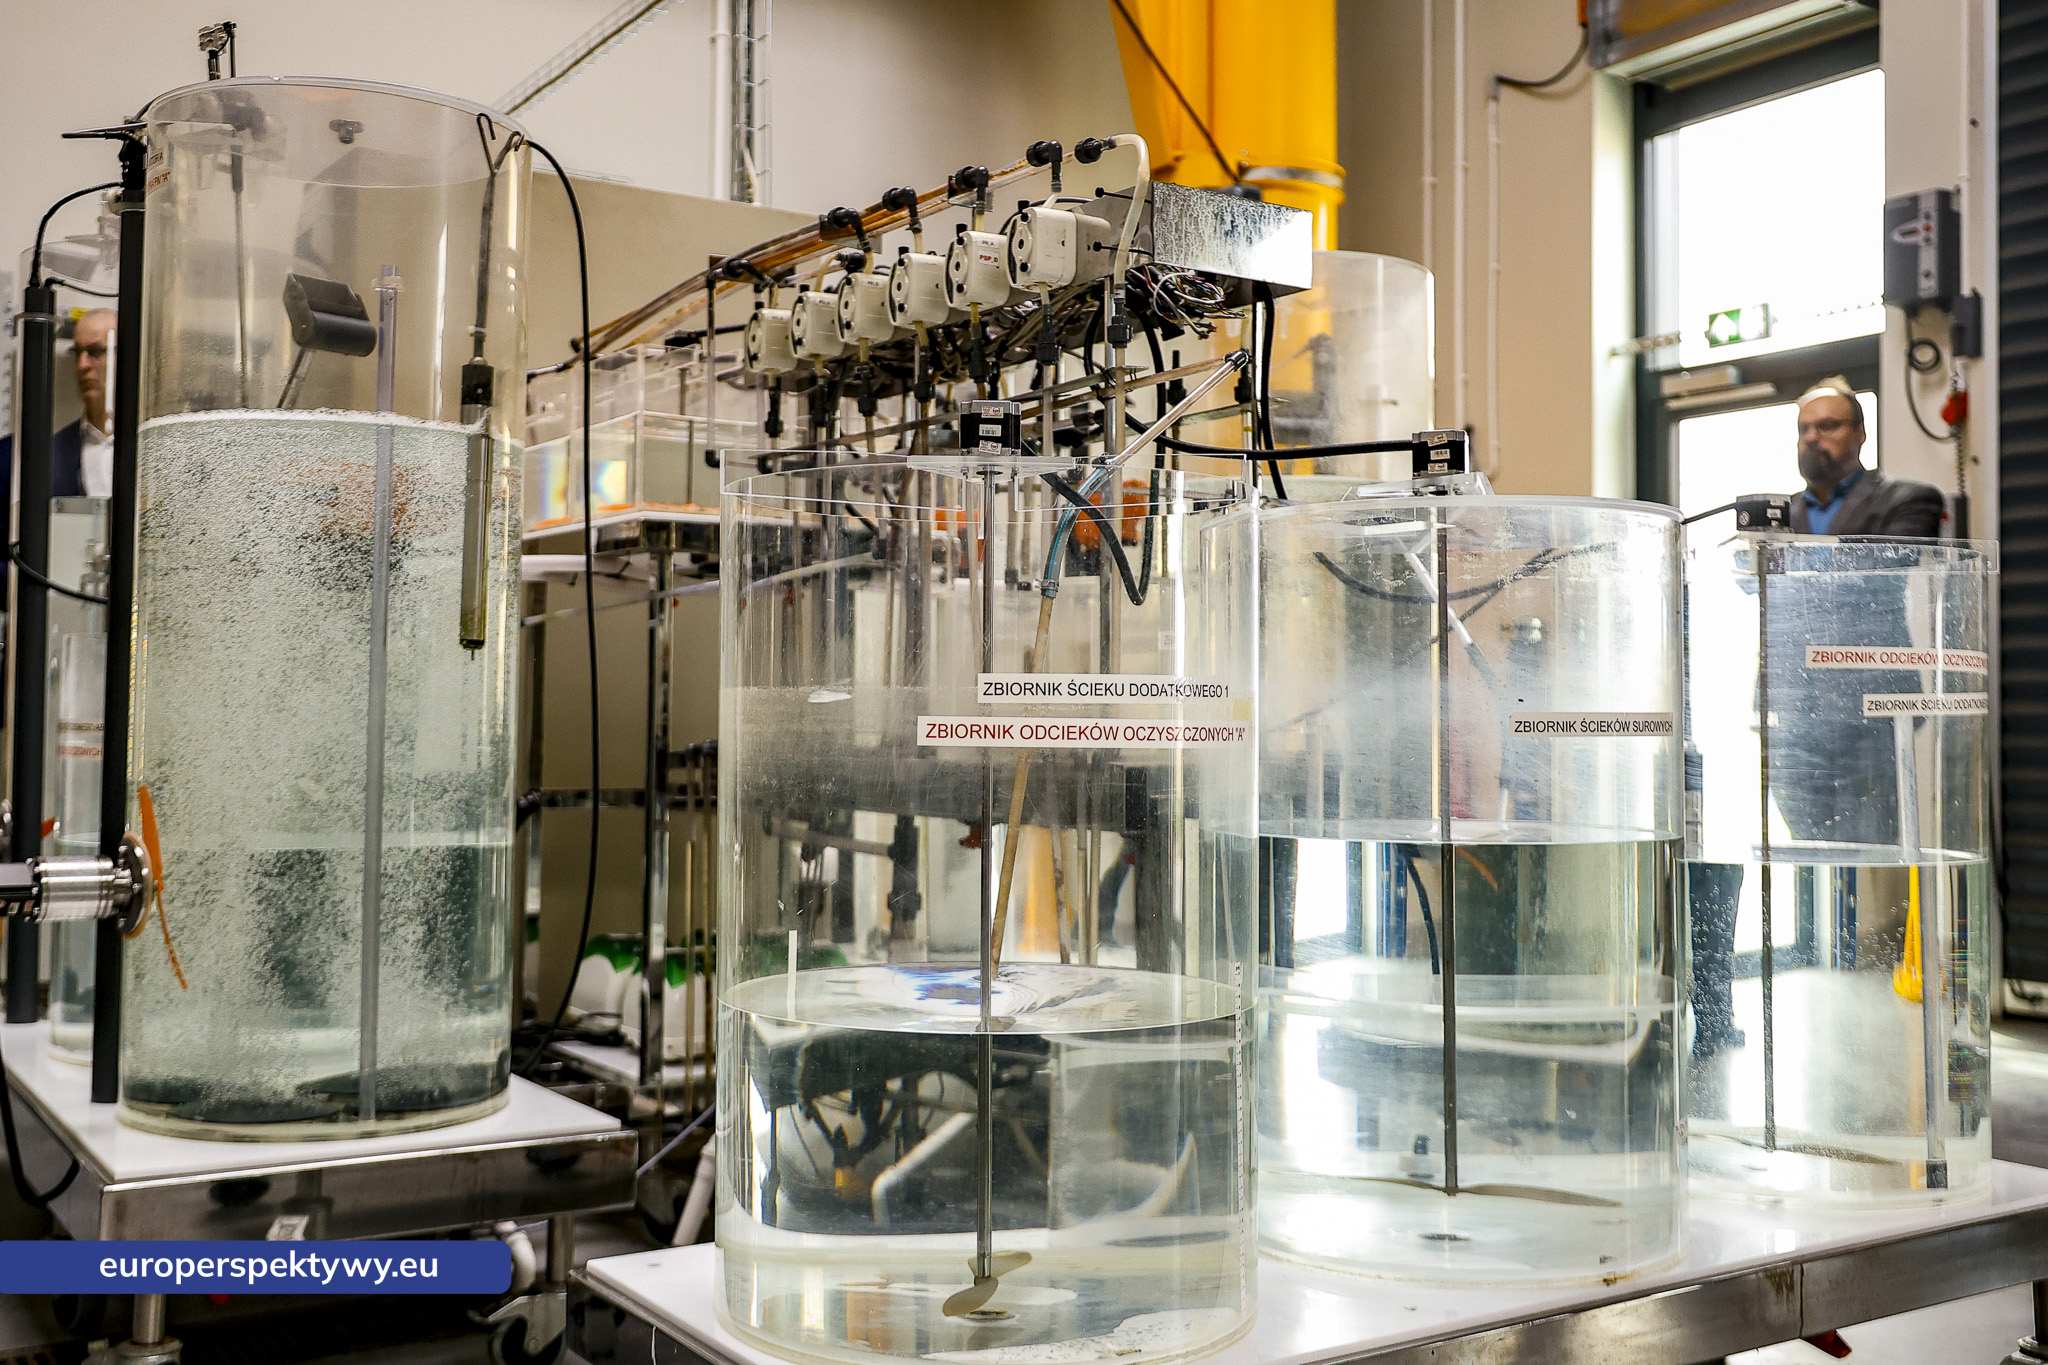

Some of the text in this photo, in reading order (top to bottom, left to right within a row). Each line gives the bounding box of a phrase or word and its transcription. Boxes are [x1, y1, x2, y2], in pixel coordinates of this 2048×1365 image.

[1811, 650, 1877, 664] ZBIORNIK
[983, 678, 1229, 698] ZBIORNIK ŚCIEKU DODATKOWEGO 1
[1867, 699, 1919, 712] ZBIORNIK
[925, 722, 1246, 742] ZBIORNIK ODCIEKÓW OCZYSZCZONYCH "A"
[1514, 717, 1673, 733] ZBIORNIK ŚCIEKÓW SUROWYCH
